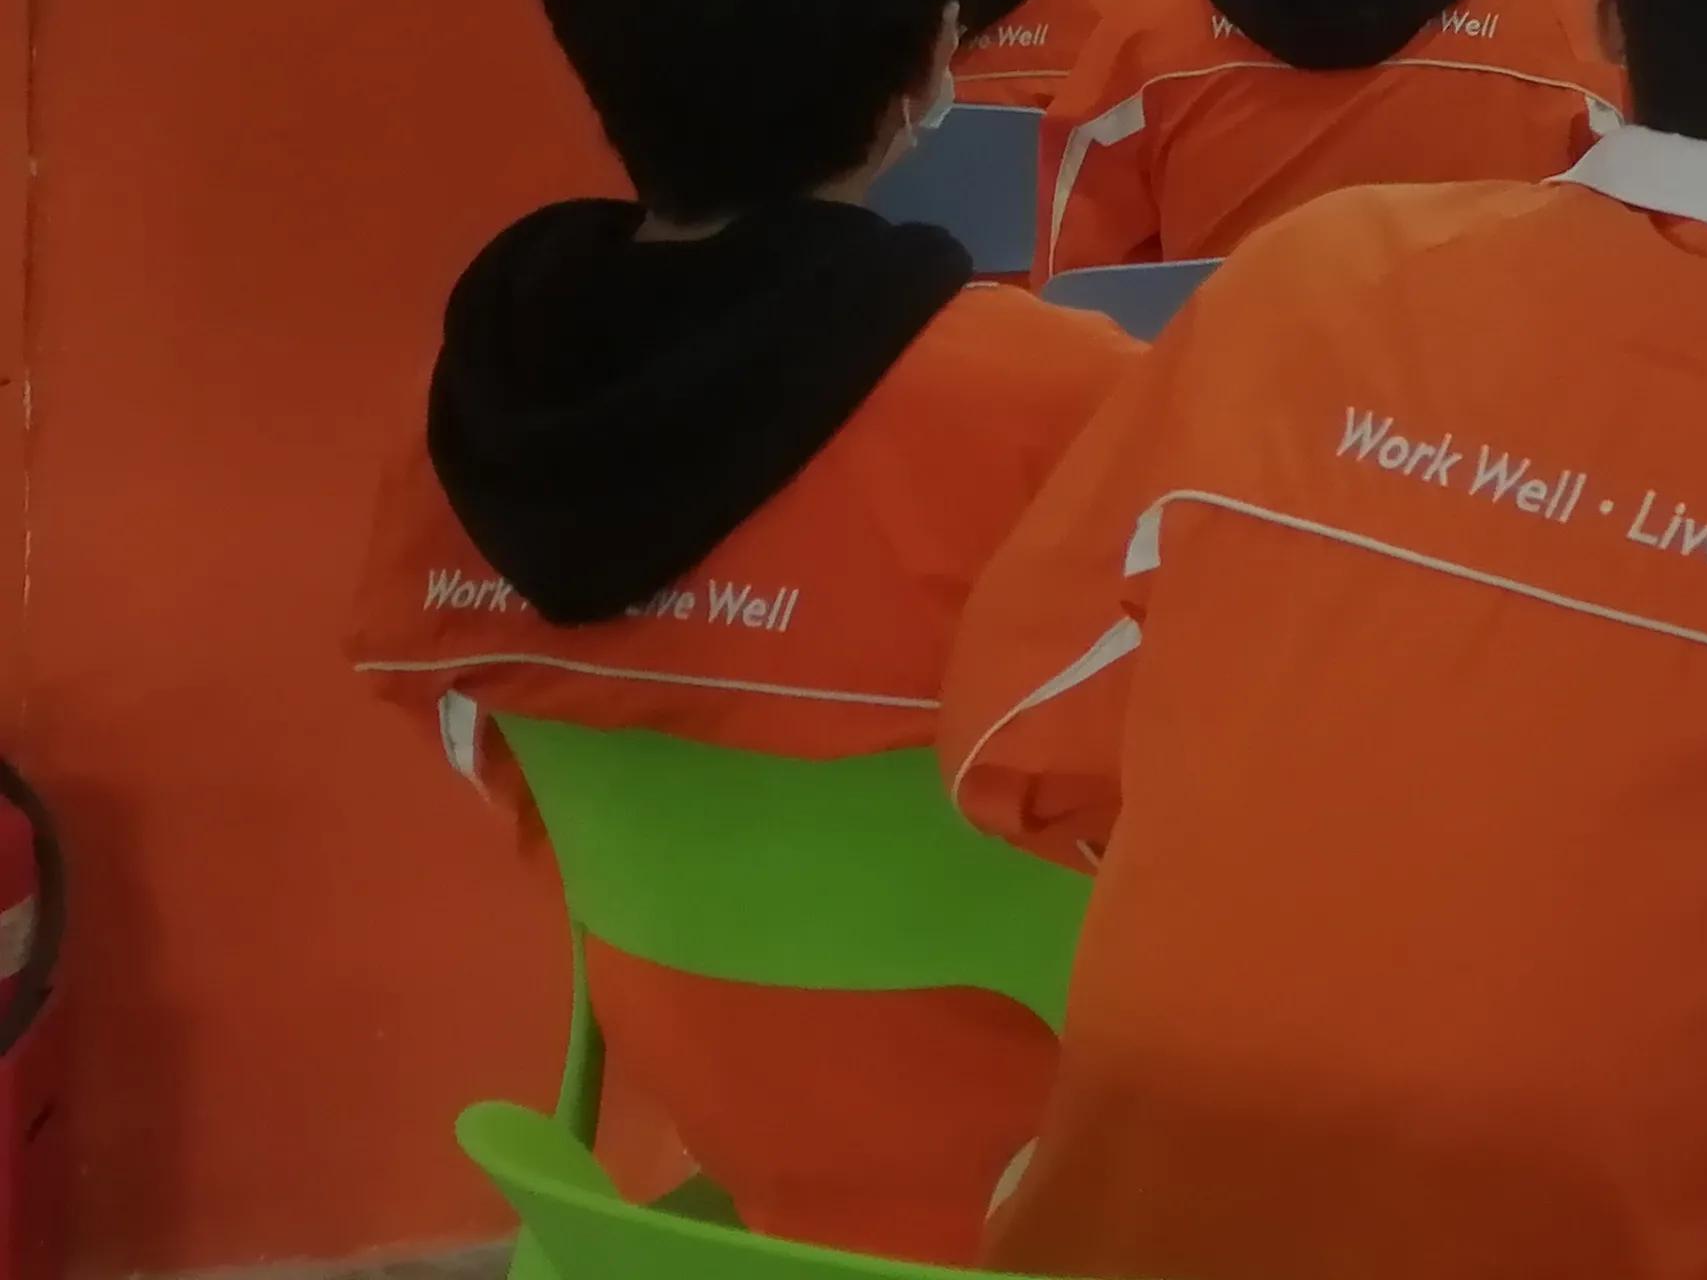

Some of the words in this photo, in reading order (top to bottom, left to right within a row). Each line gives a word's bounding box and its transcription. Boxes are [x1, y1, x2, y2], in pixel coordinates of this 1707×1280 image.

[997, 23, 1049, 48] Well
[1440, 9, 1499, 39] Well
[1335, 405, 1463, 487] Work
[1468, 443, 1587, 524] Well
[422, 567, 517, 612] Work
[707, 578, 800, 633] Well
